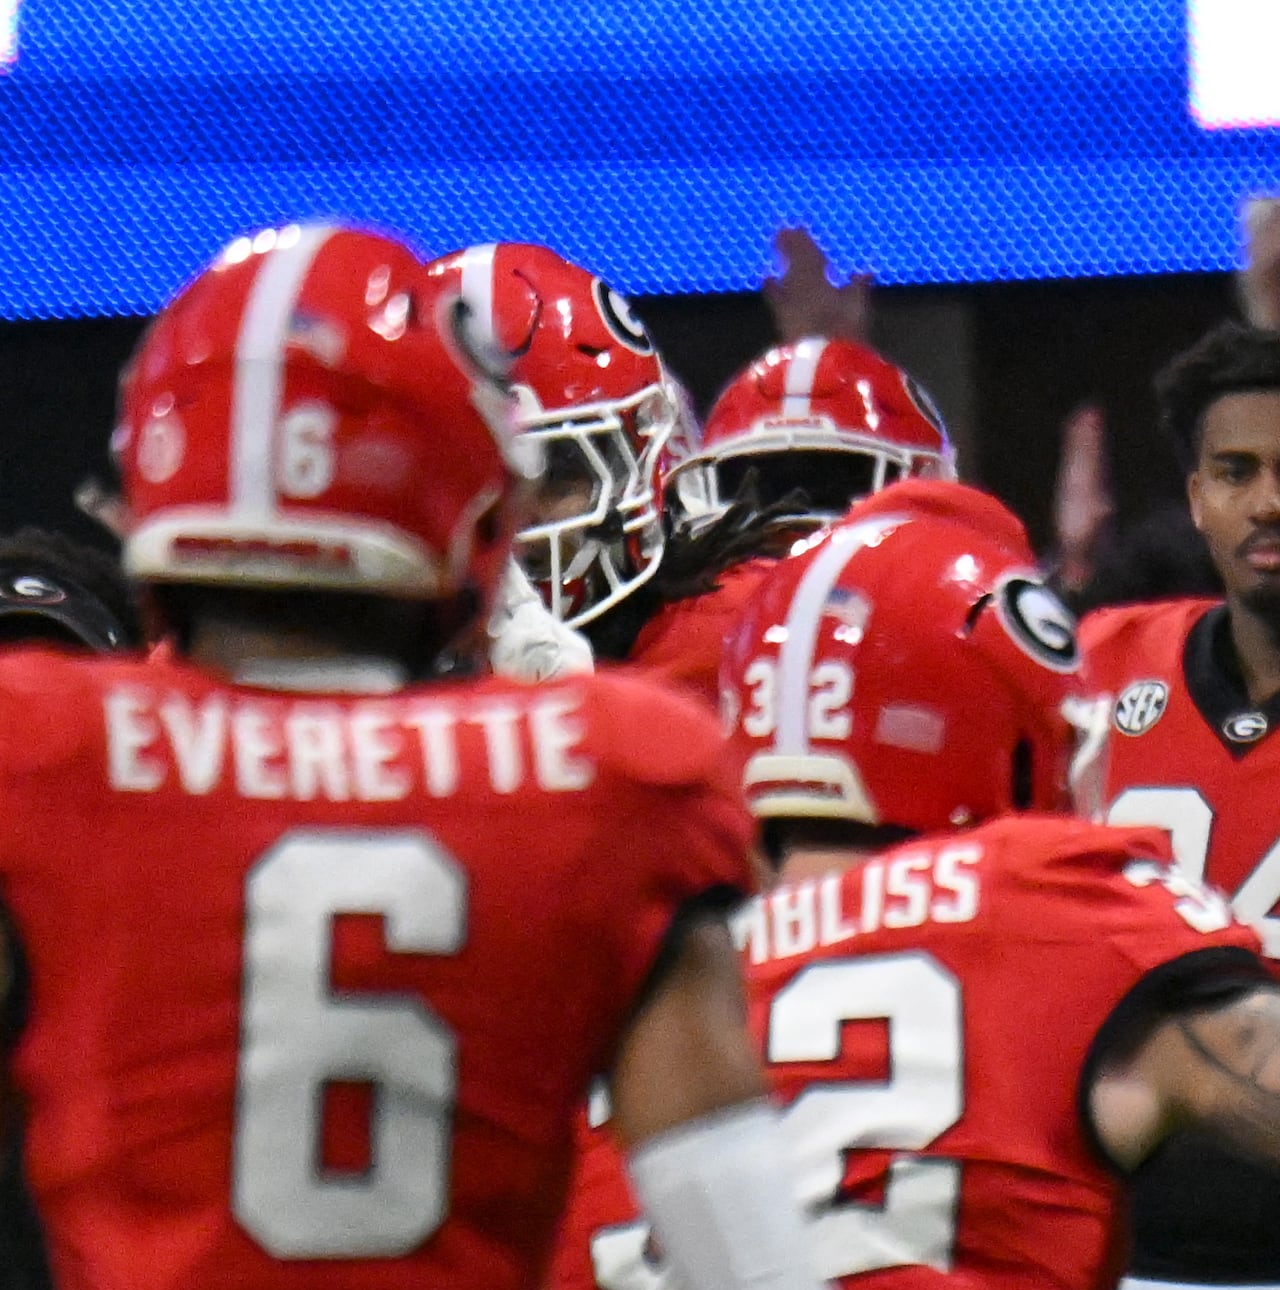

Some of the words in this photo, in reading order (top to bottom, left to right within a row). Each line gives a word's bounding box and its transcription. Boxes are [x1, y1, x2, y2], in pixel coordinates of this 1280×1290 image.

[282, 398, 338, 498] 6
[104, 688, 595, 799] EVERETTE
[743, 659, 854, 742] 32
[233, 830, 467, 1260] 6
